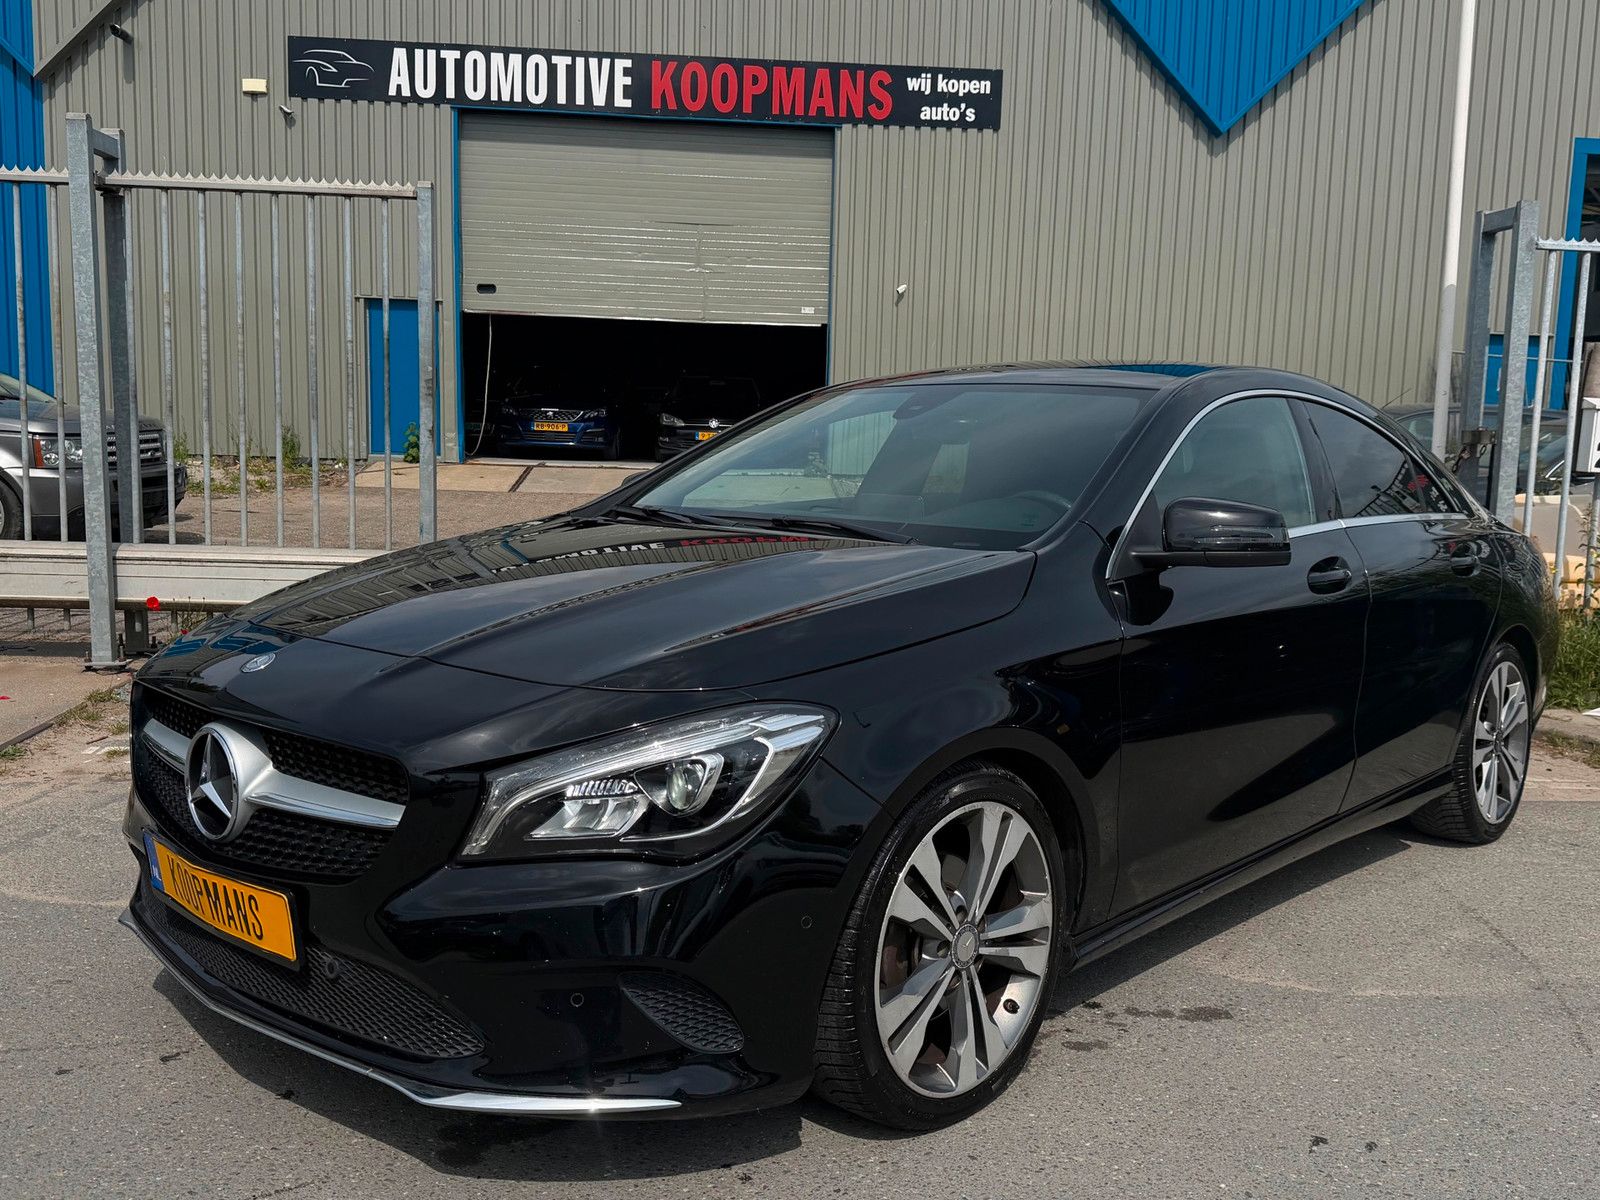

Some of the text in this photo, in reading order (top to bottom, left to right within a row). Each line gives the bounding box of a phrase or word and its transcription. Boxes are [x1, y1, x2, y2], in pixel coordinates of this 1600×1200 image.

[388, 47, 894, 121] AUTOMOTIVE KOOPMANS
[906, 73, 991, 97] wij kopen
[920, 102, 976, 122] auto's
[166, 854, 264, 941] KOOPMANS
